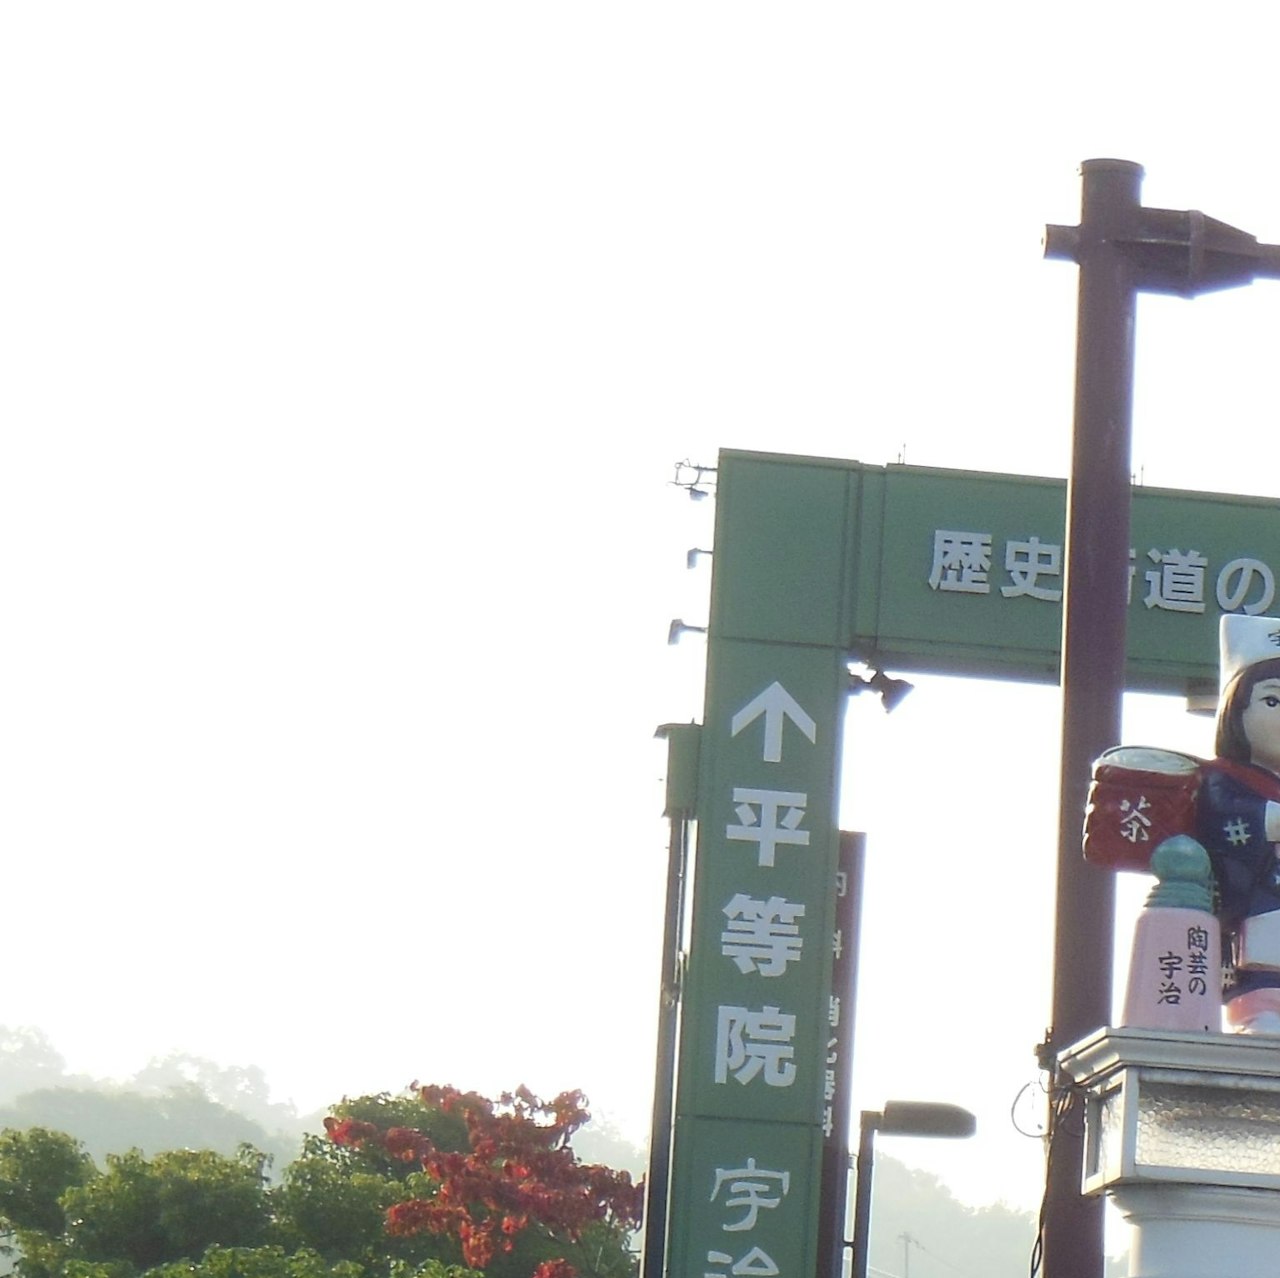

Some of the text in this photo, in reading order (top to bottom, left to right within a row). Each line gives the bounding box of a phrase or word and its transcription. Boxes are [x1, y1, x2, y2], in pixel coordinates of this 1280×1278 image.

[1119, 797, 1152, 843] 茶
[714, 785, 811, 1088] 平等院
[1187, 926, 1209, 996] 陶芸の
[1157, 952, 1183, 1005] 宇治
